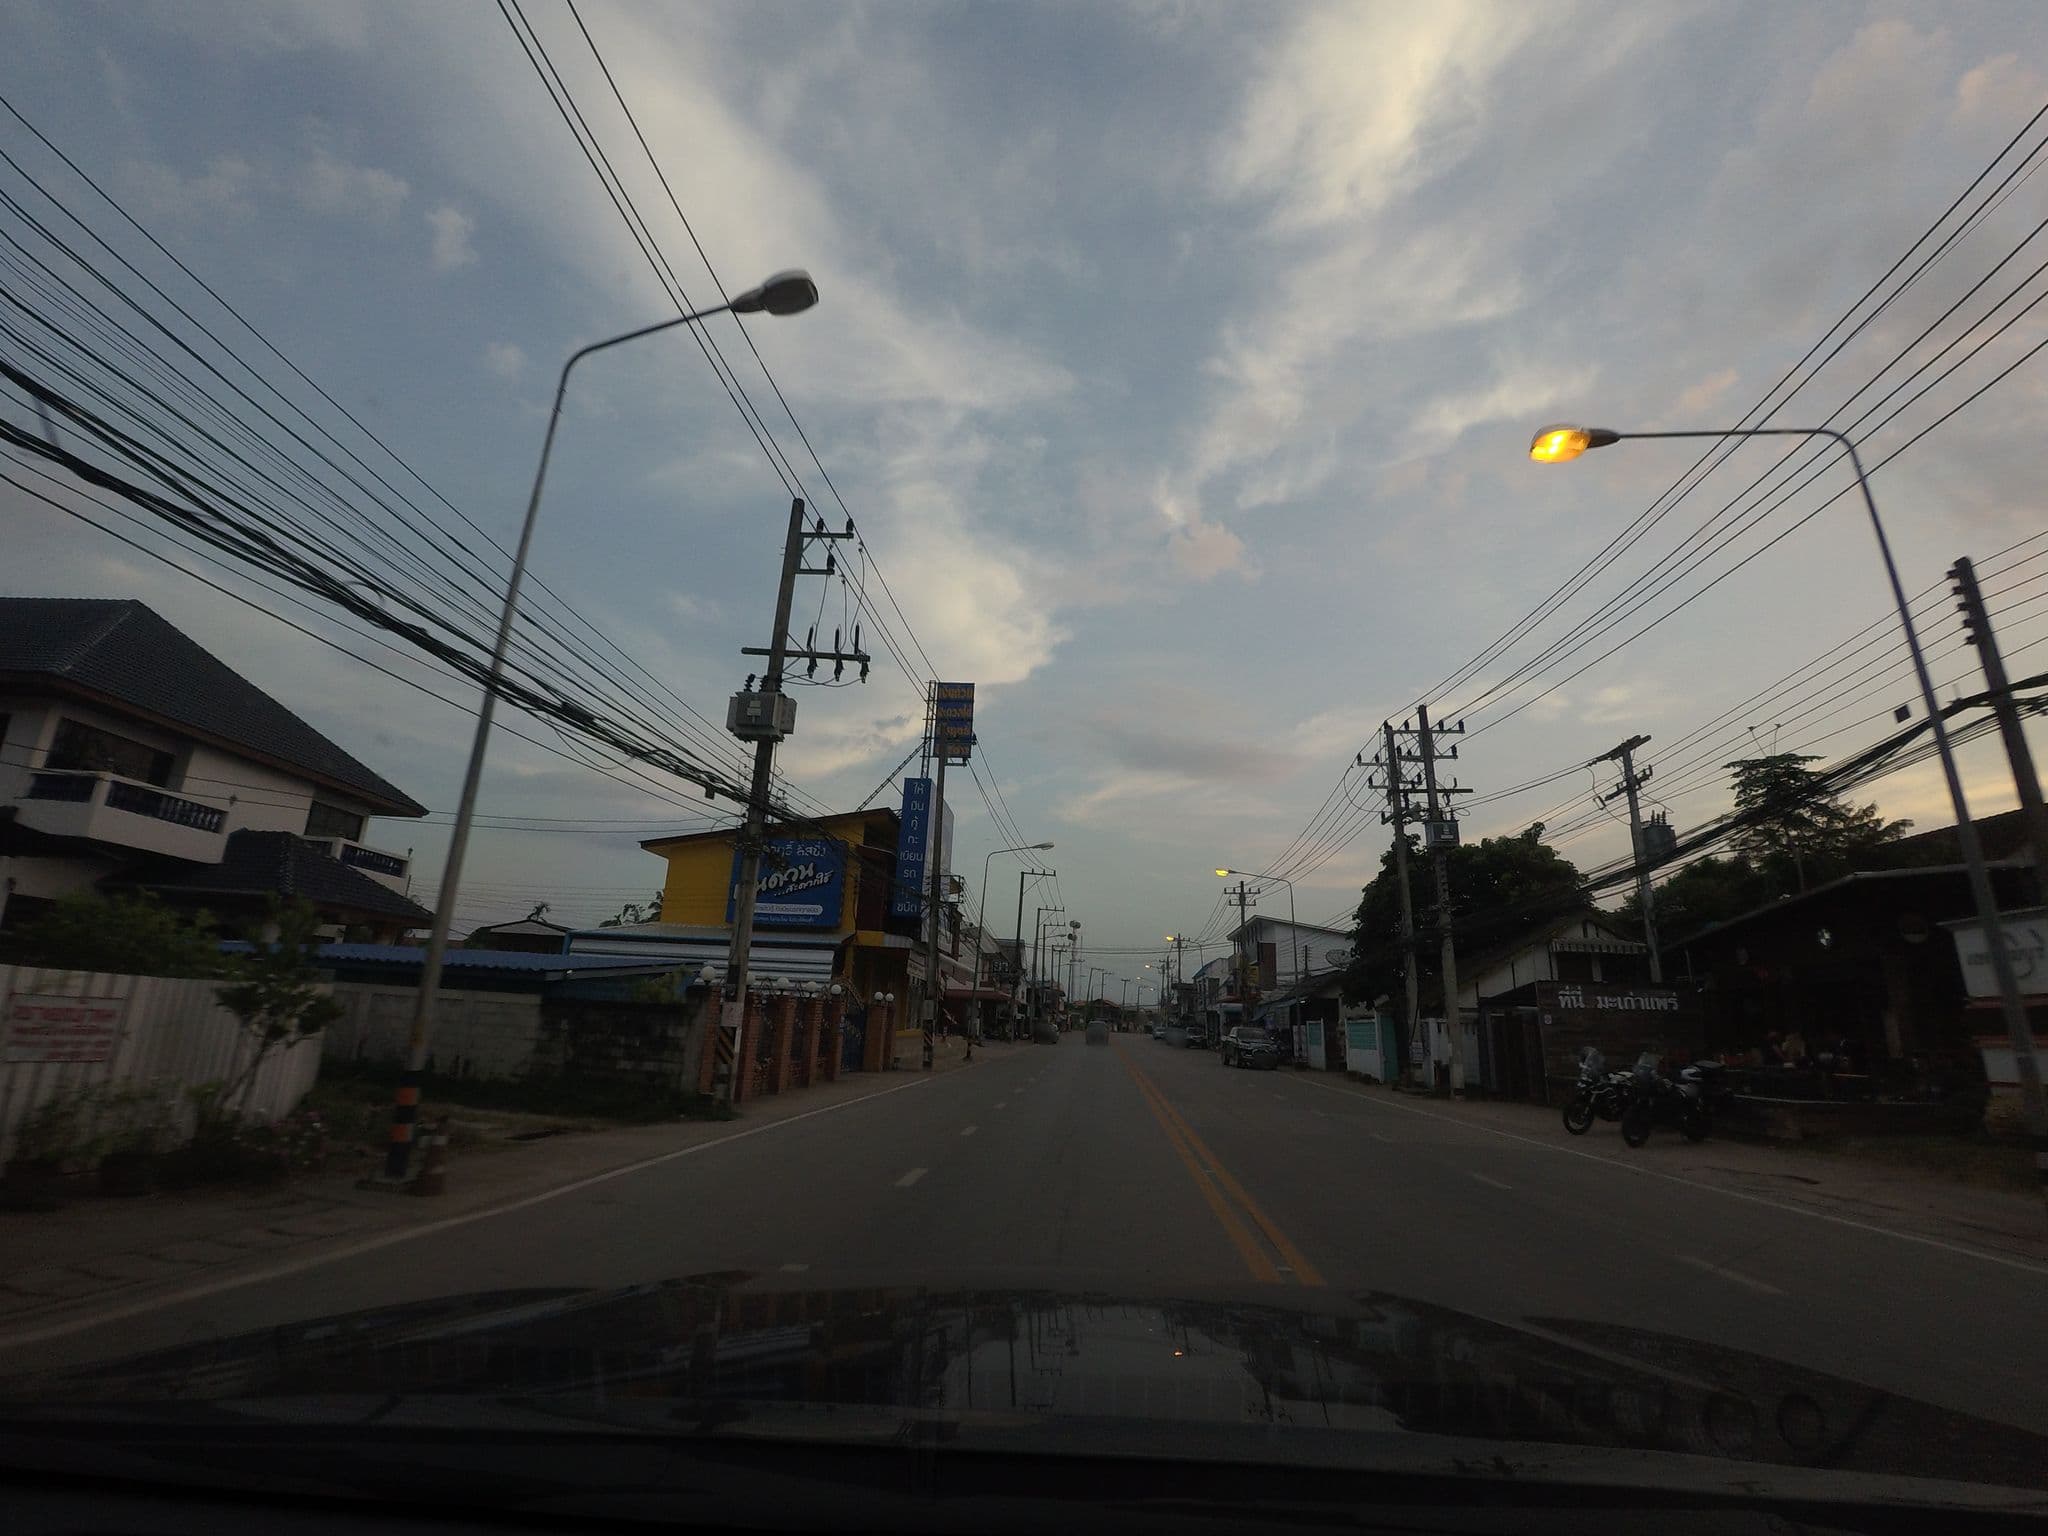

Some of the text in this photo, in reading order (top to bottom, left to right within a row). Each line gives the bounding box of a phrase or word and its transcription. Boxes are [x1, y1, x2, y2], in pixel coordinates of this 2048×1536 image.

[903, 868, 916, 879] รถ
[1558, 985, 1585, 1009] ที่นี่
